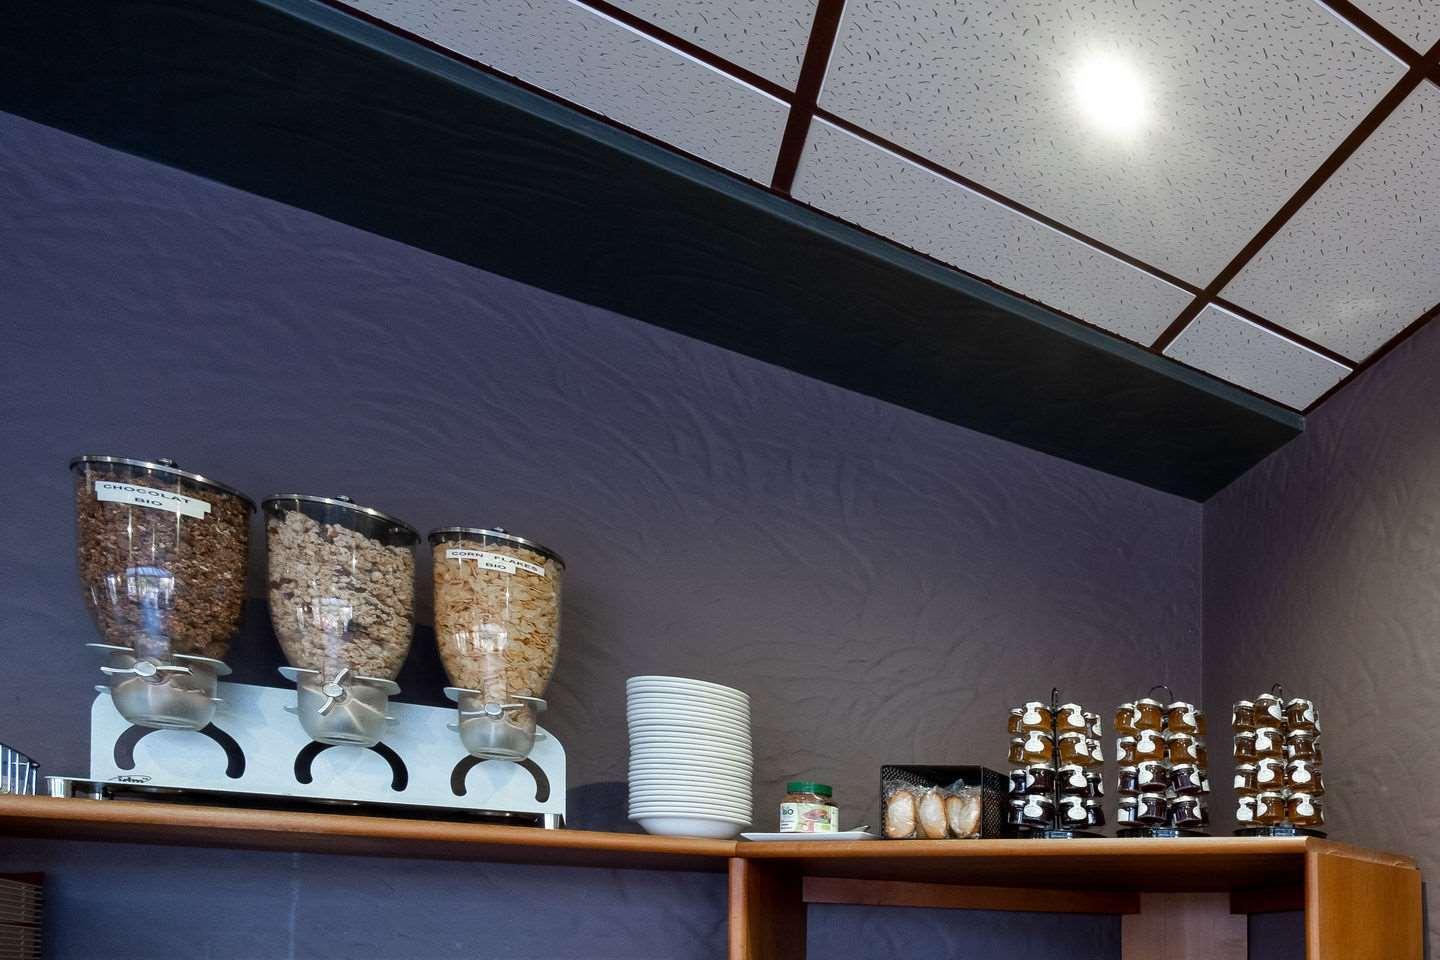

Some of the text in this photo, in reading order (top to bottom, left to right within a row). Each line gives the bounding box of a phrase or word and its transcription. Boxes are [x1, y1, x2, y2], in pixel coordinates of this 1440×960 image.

[103, 484, 191, 504] CHOCOLAT
[134, 497, 163, 506] BIO
[485, 562, 507, 570] BIO
[494, 555, 538, 572] FLAKES
